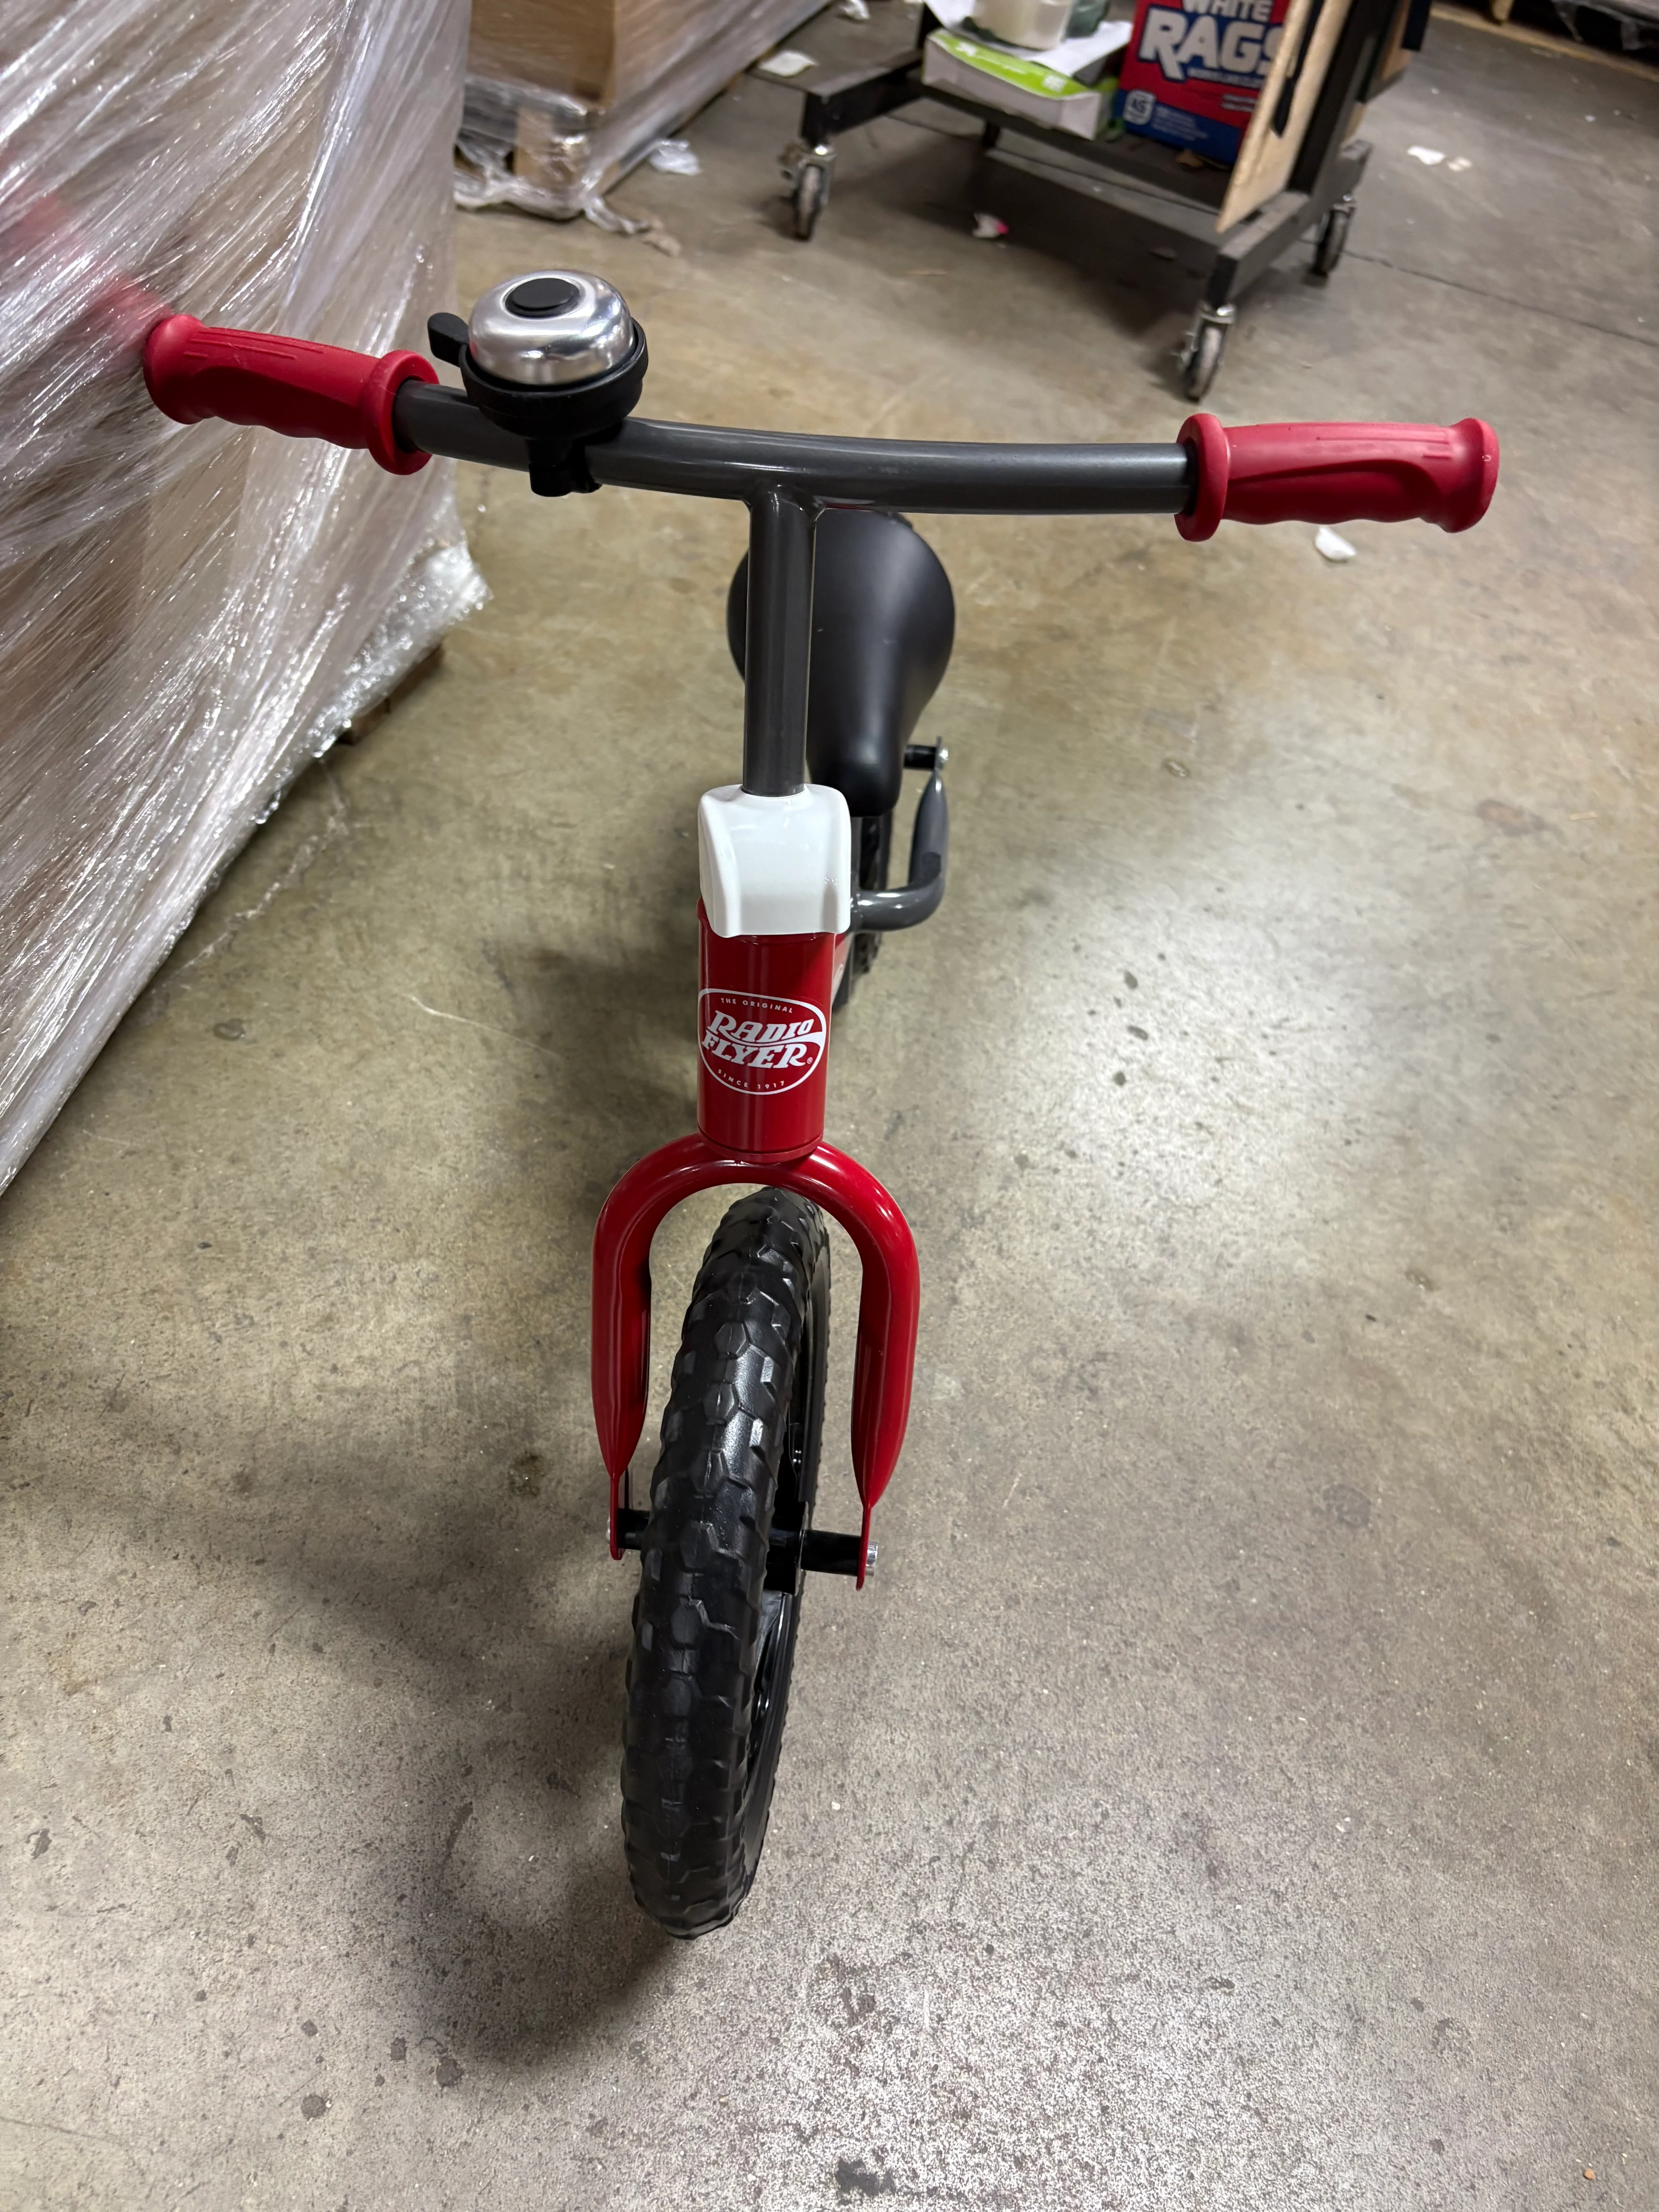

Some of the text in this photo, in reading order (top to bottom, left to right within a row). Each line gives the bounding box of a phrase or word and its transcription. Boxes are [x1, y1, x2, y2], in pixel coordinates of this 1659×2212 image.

[742, 1000, 793, 1013] ORIGINAL
[707, 1010, 814, 1042] RADIO
[701, 1030, 806, 1068] FLYER
[718, 1069, 785, 1089] SINCE 1917
